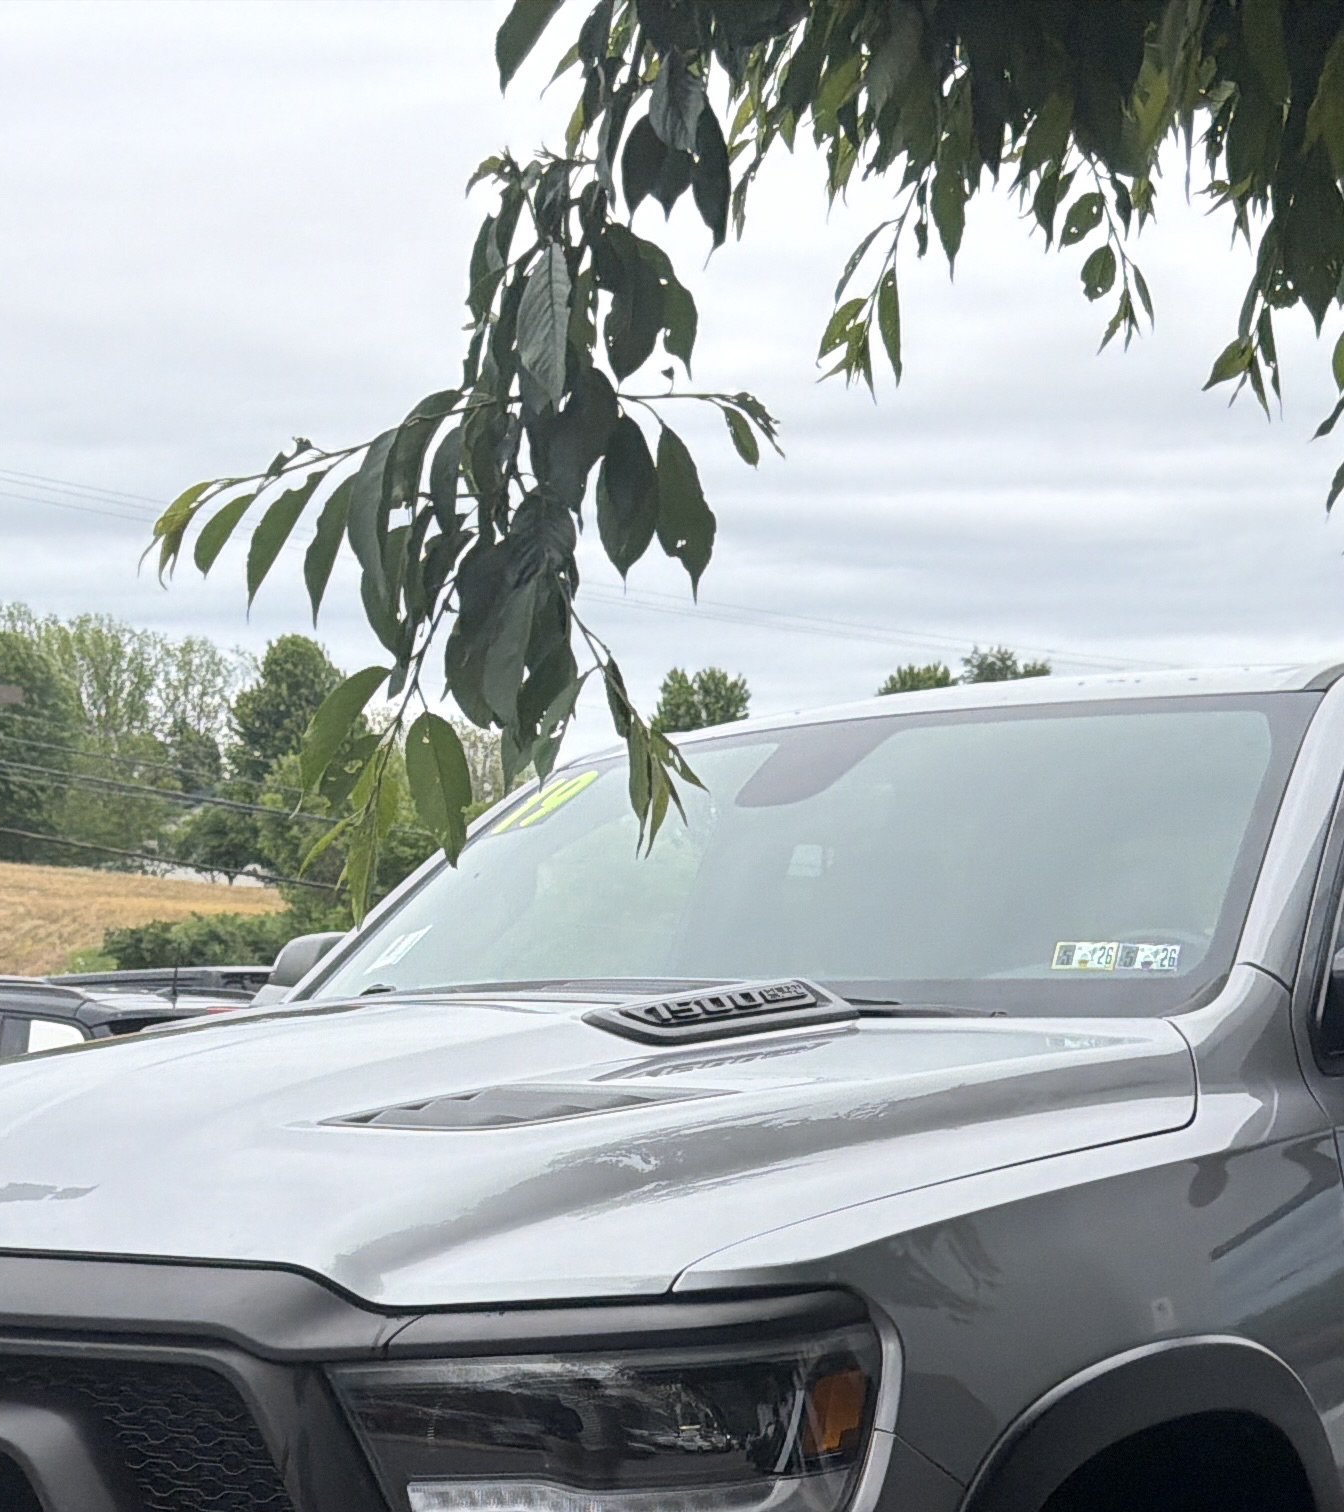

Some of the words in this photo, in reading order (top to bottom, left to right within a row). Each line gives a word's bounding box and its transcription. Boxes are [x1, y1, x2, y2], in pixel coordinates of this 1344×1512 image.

[491, 769, 599, 834] 19
[1097, 945, 1114, 965] 26
[1159, 947, 1177, 968] 26
[644, 991, 763, 1024] 1500
